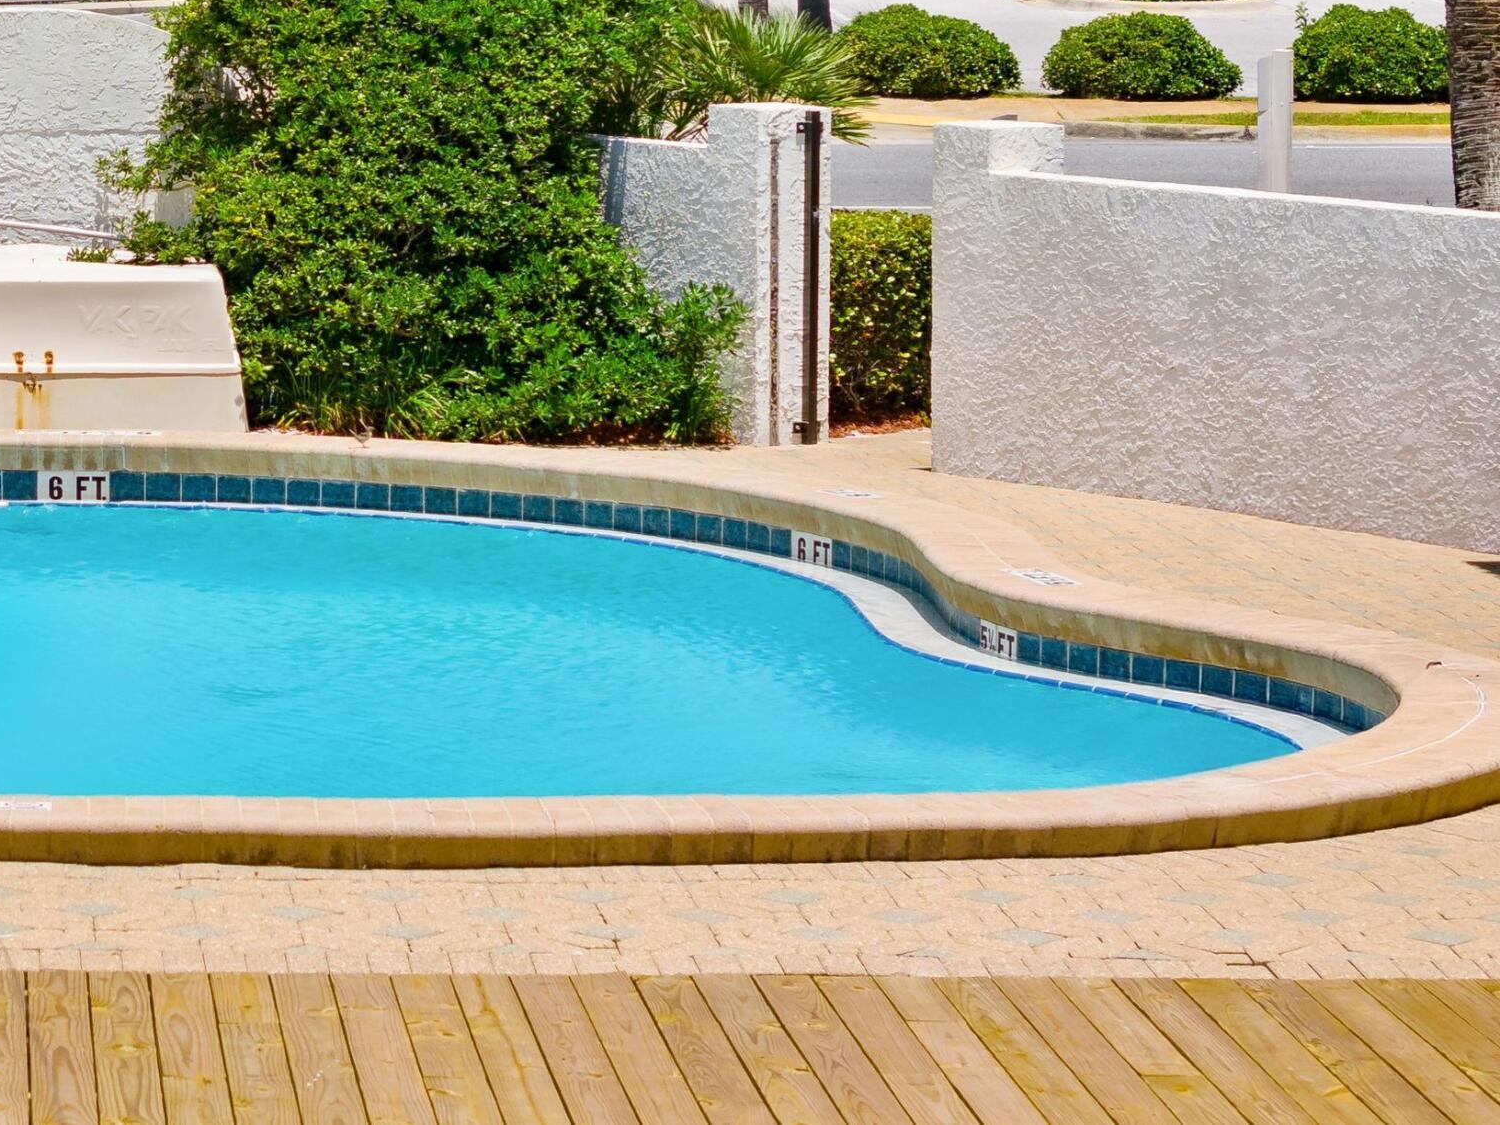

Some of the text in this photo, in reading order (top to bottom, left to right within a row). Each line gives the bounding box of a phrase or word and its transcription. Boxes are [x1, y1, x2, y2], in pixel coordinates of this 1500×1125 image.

[49, 476, 107, 501] 6 FT.
[797, 537, 806, 561] 6
